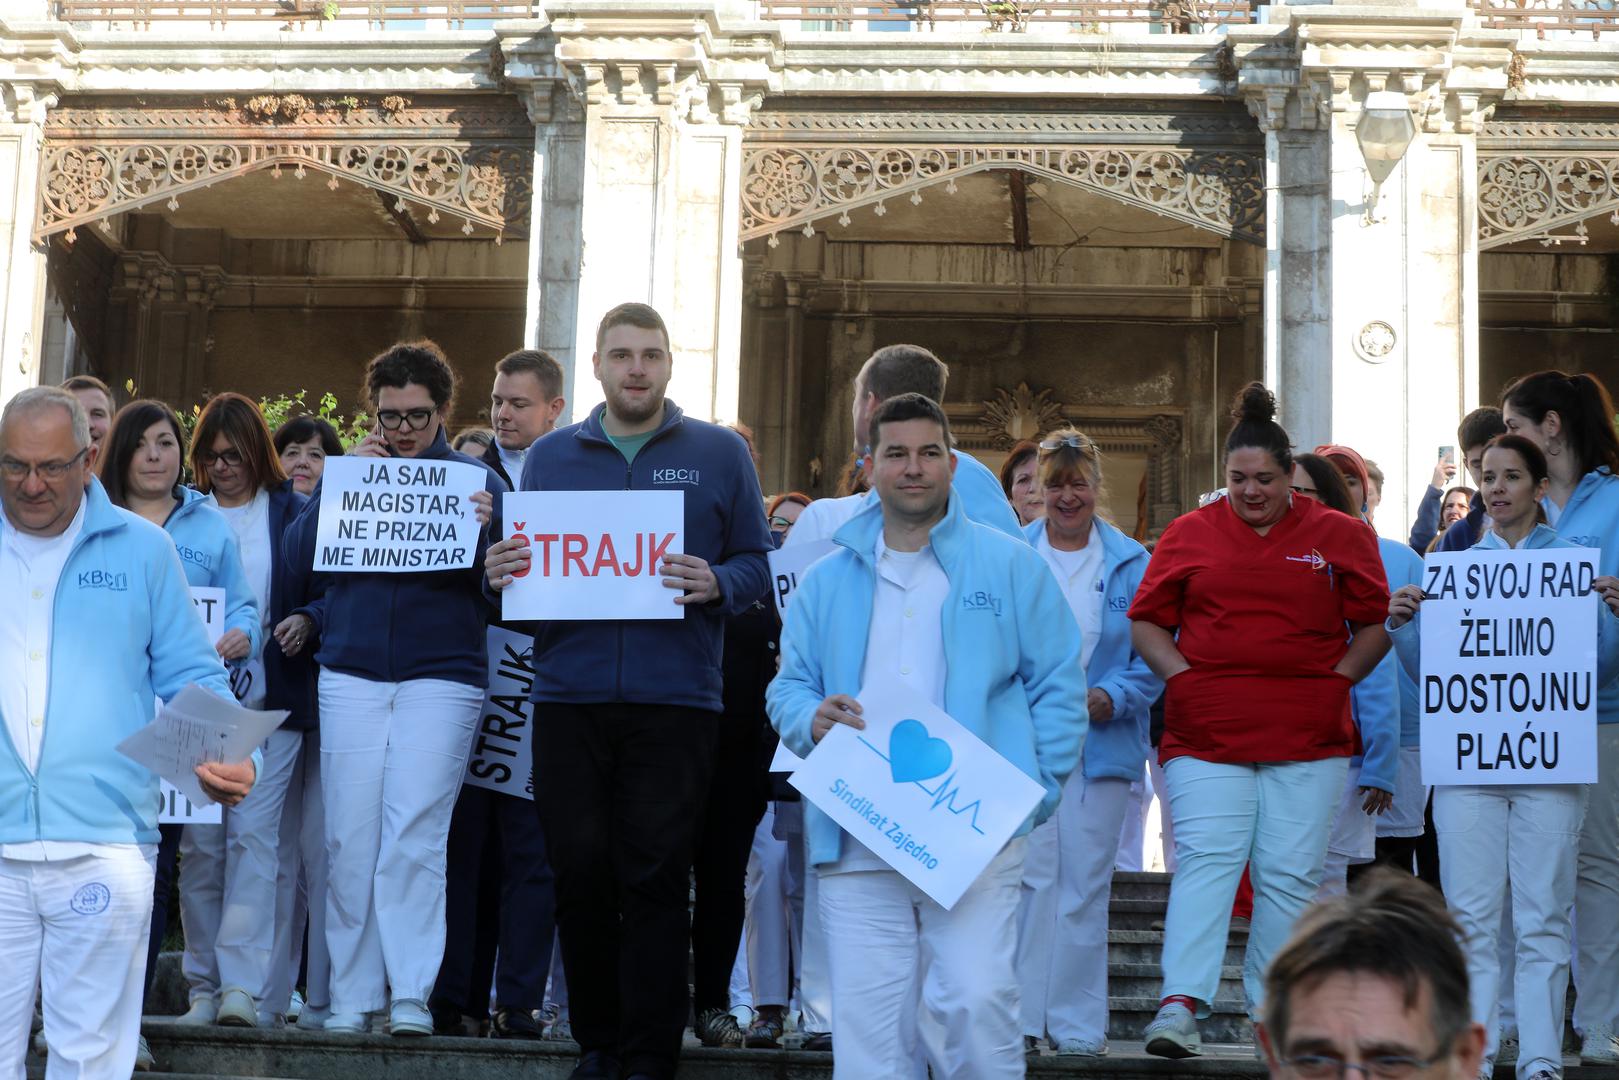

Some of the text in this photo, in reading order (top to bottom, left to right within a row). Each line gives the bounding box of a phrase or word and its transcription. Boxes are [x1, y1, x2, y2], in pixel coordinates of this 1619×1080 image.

[362, 464, 447, 487] JA SAM
[342, 491, 465, 519] MAGISTAR,
[338, 519, 457, 542] NE PRIZNA
[510, 522, 676, 578] ŠTRAJK
[322, 546, 466, 567] ME MINISTAR
[1425, 561, 1594, 601] ZA SVOJ RAD
[1459, 608, 1555, 658] ŽELIMO
[1425, 671, 1591, 714] DOSTOJNU
[1457, 721, 1559, 770] PLAĆU
[829, 778, 938, 870] Sindikat Zajedno
